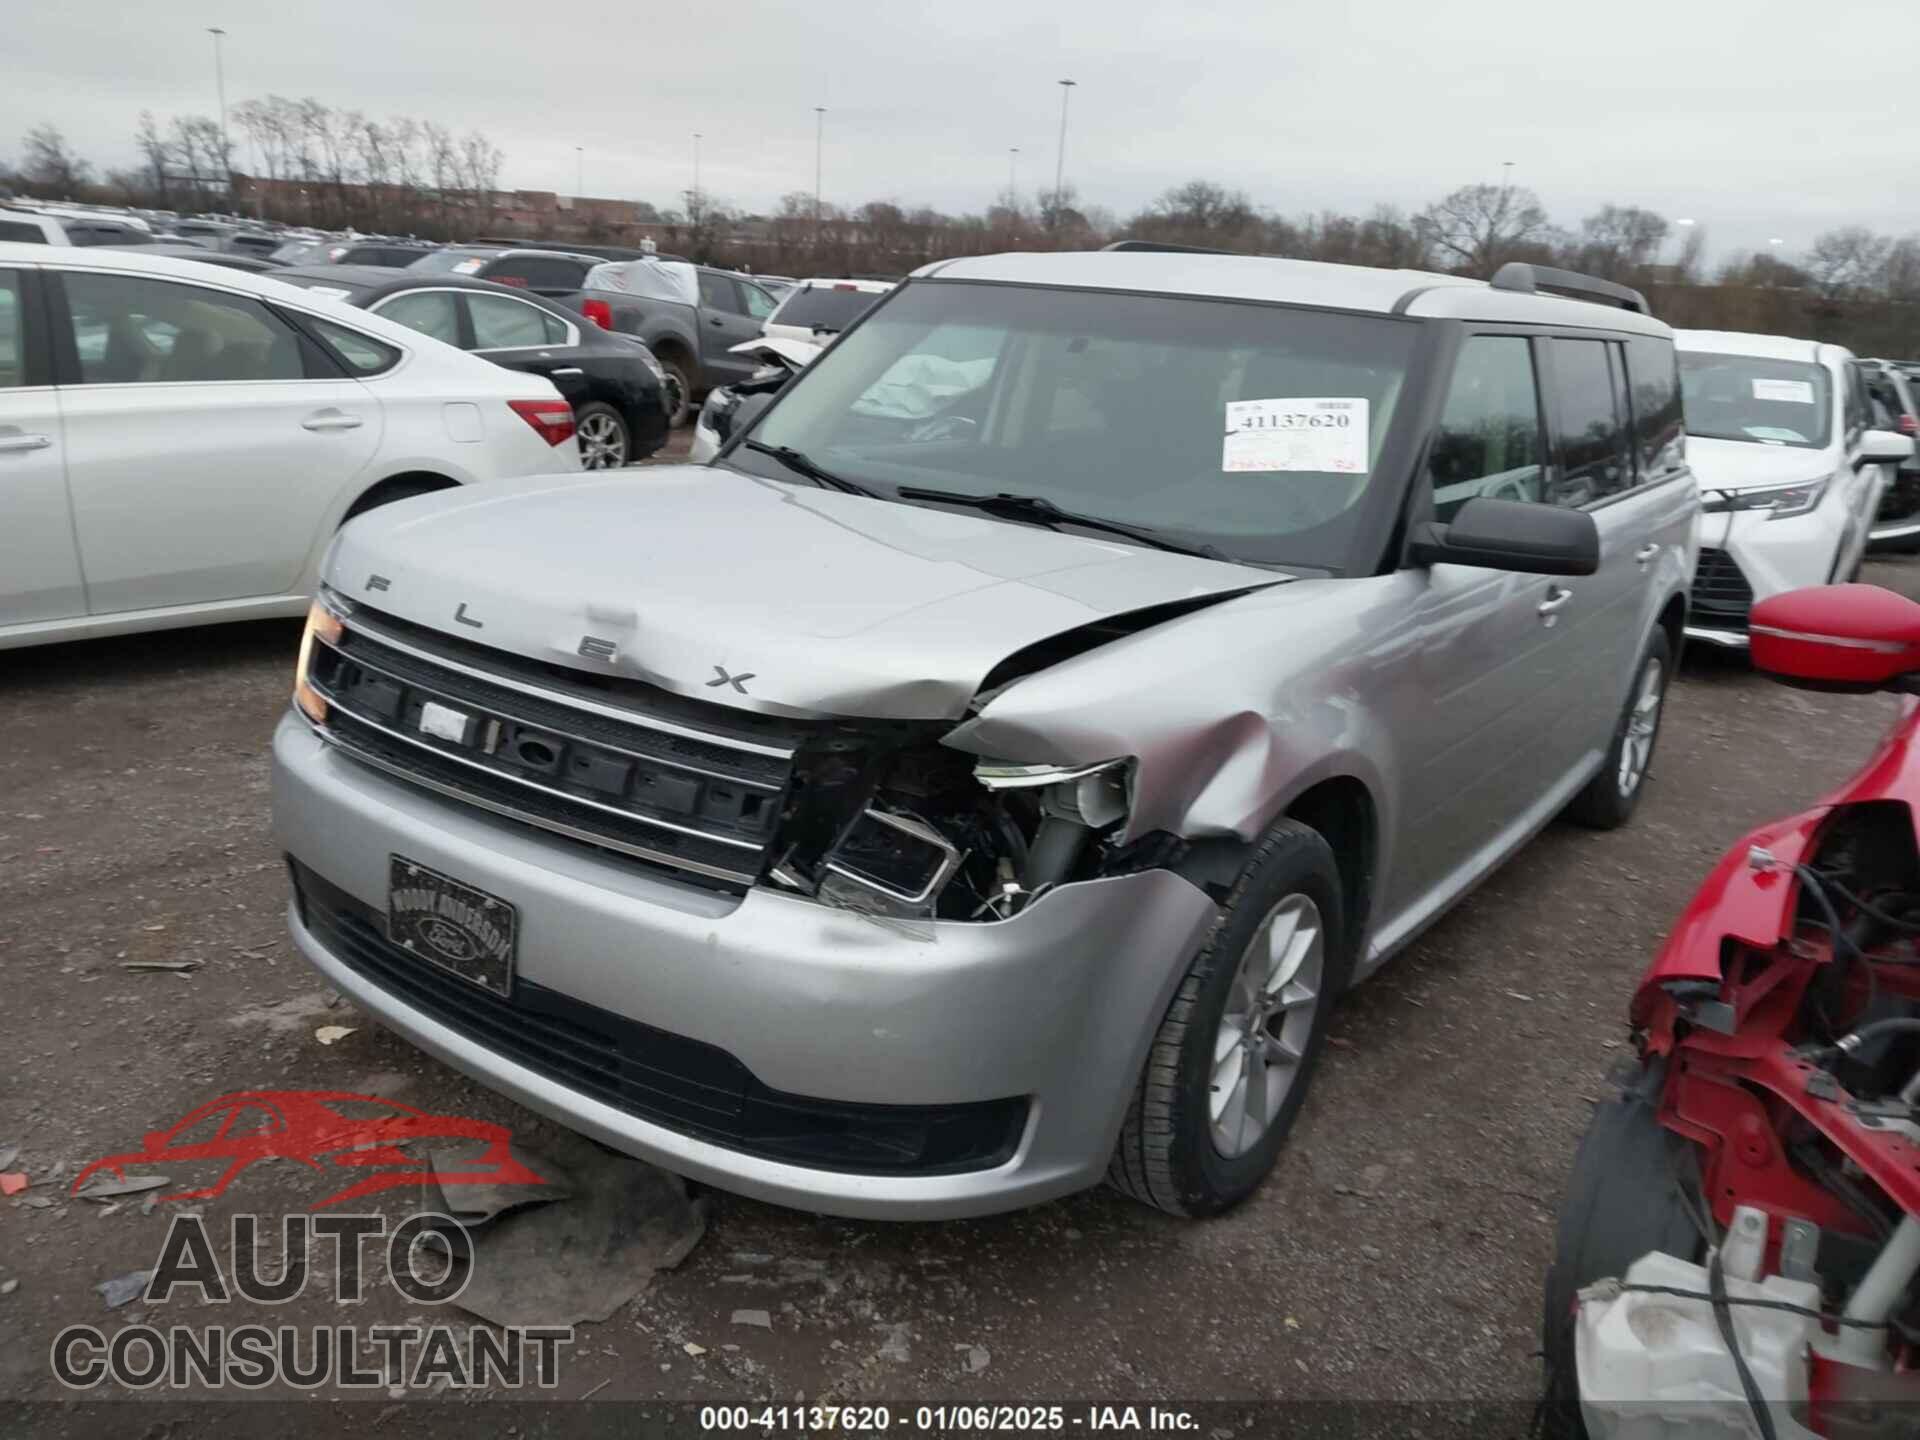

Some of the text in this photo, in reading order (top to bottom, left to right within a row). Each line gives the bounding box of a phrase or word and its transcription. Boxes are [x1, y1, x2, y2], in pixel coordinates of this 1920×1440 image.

[1242, 413, 1350, 429] 41137620
[364, 574, 756, 695] FLEX
[428, 923, 467, 956] Ford
[438, 894, 512, 962] ANDERSON
